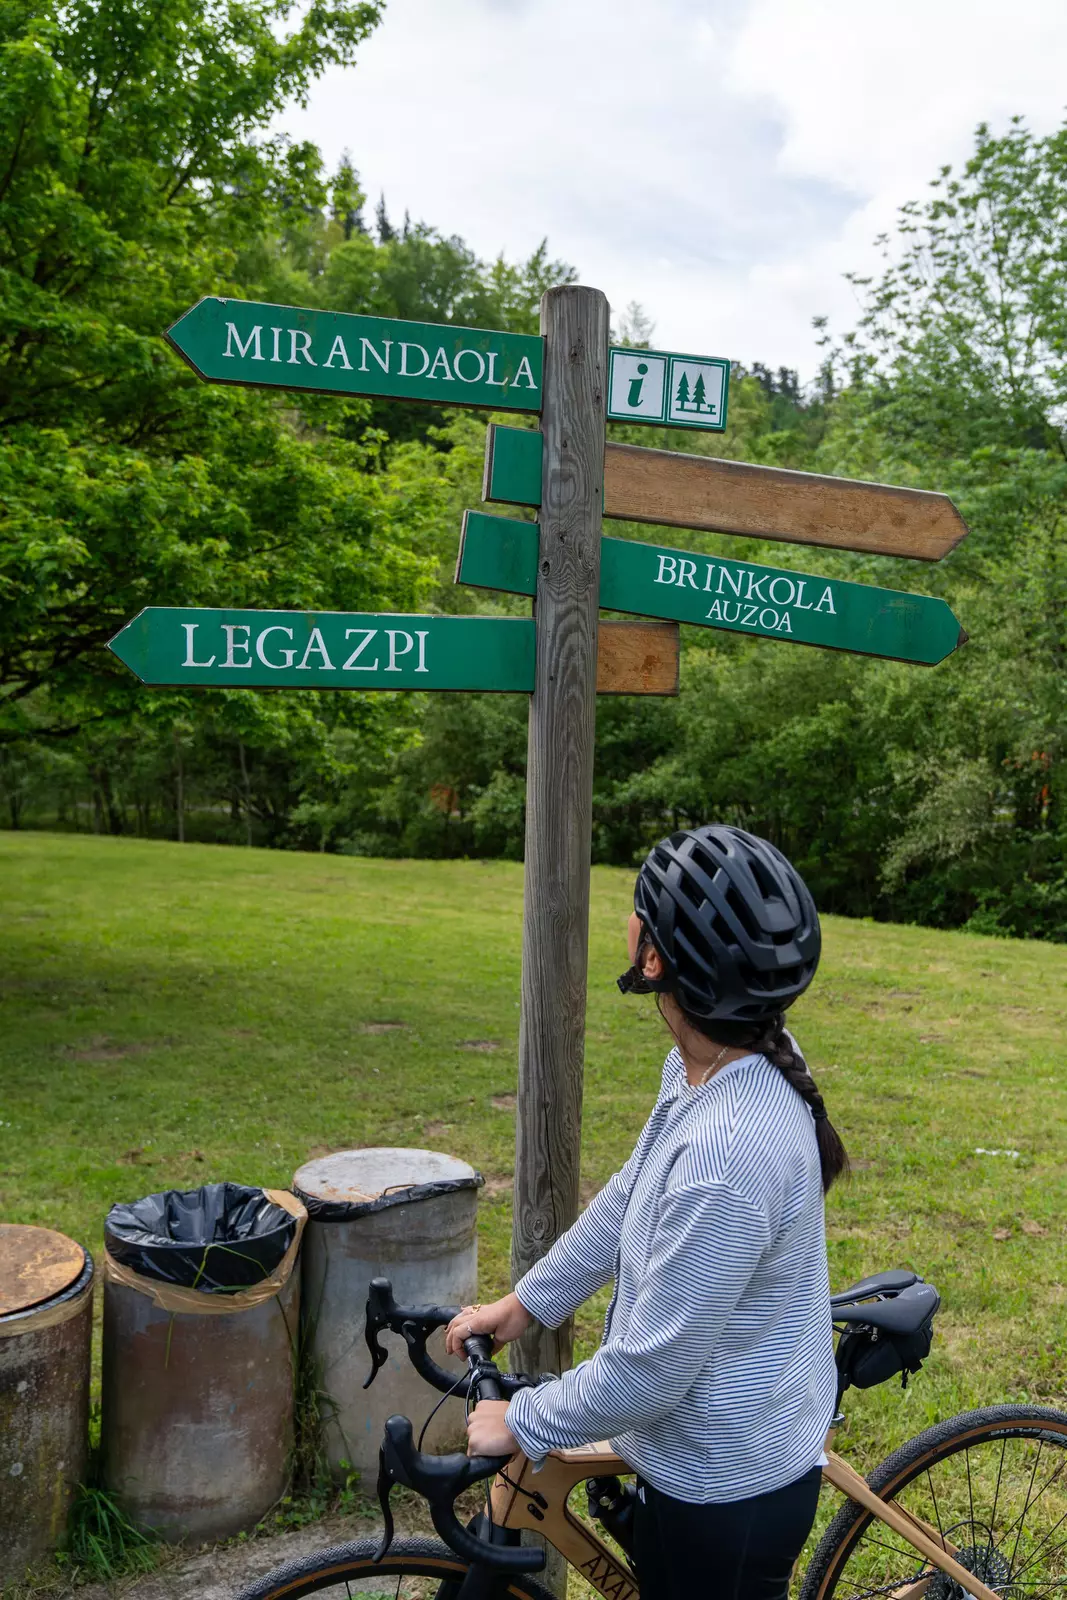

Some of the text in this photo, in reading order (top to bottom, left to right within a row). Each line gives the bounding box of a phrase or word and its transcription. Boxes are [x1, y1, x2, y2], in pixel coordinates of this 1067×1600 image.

[222, 322, 538, 390] MIRANDAOLA
[654, 554, 837, 615] BRINKOLA
[706, 599, 793, 634] AUZOA
[181, 622, 430, 673] LEGAZPI
